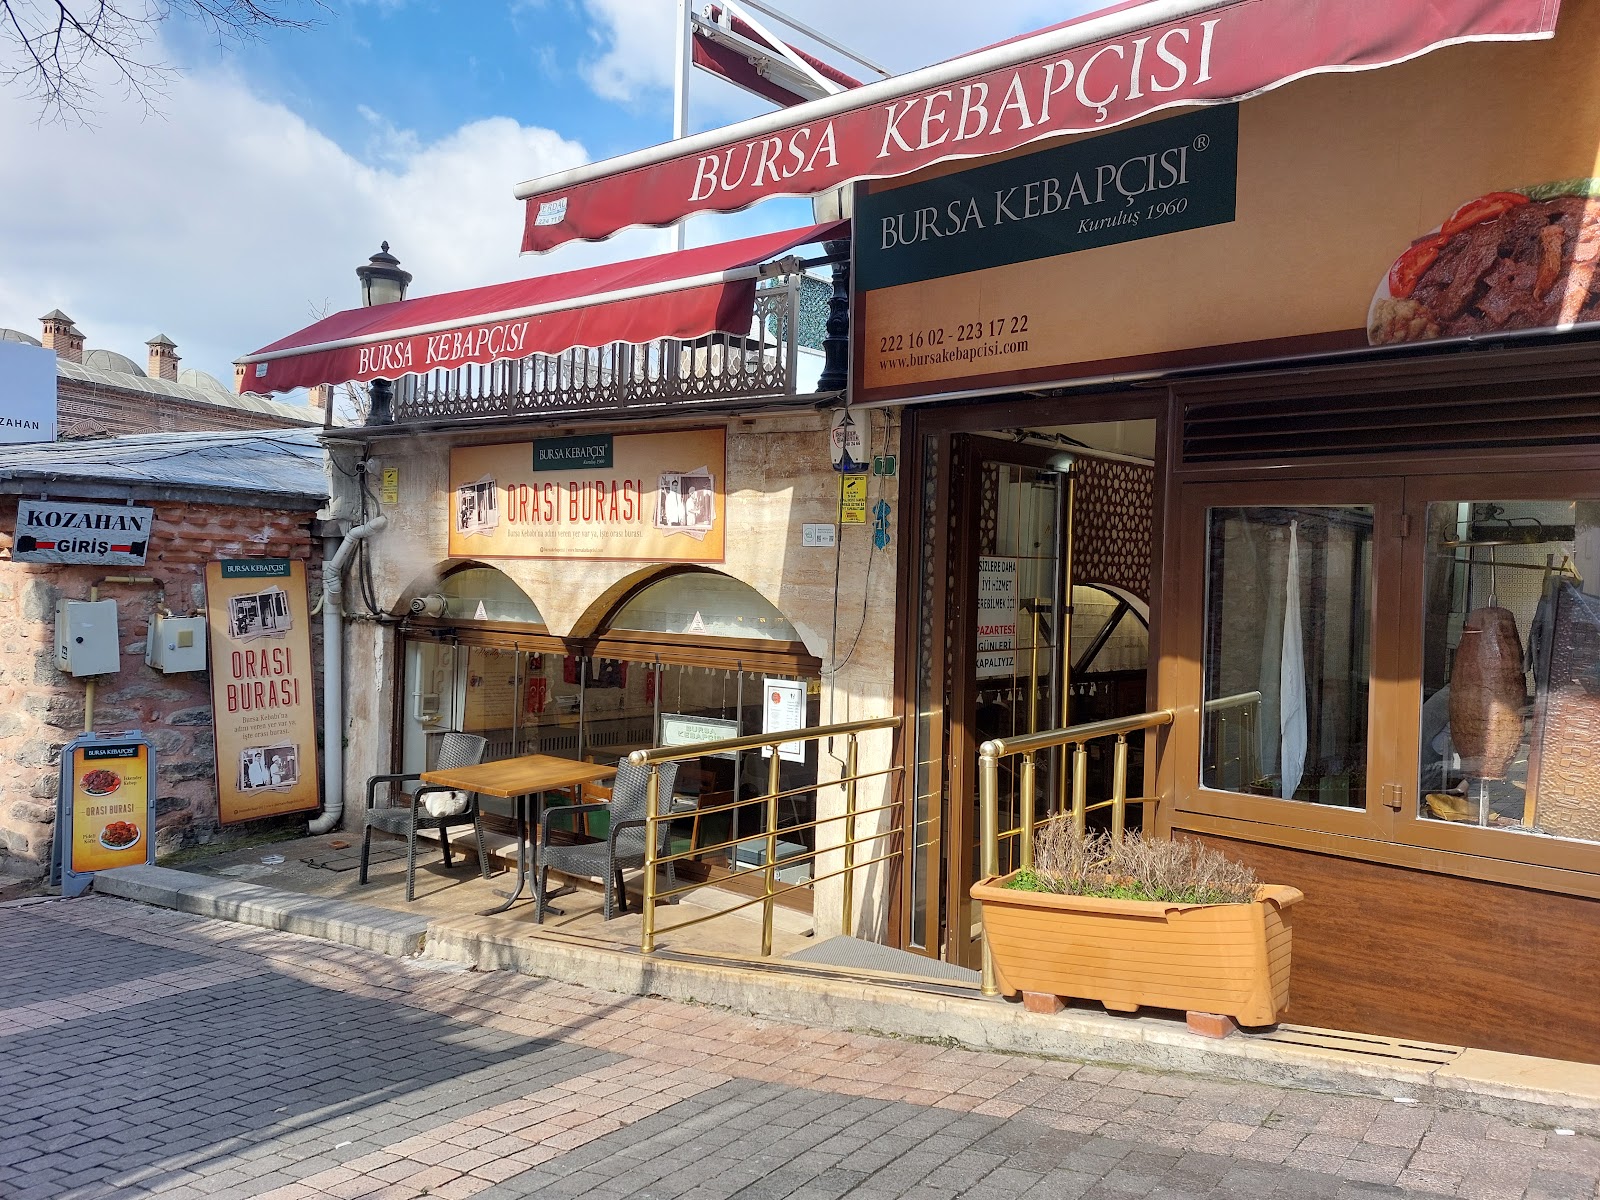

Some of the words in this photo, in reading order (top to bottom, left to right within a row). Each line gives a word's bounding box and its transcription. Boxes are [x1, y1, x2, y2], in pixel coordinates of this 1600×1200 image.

[687, 119, 840, 202] BURSA
[875, 17, 1222, 159] KEBAPÇISI
[880, 198, 986, 251] BURSA
[1077, 210, 1140, 234] Kuruluş
[1146, 197, 1188, 220] 1960
[357, 340, 413, 375] BURSA
[425, 321, 529, 361] KEBAPÇISI
[880, 334, 903, 353] 222
[909, 330, 924, 349] 16
[928, 328, 944, 346] 02
[957, 321, 983, 342] 223
[989, 318, 1005, 337] 17
[1010, 314, 1028, 334] 22
[879, 340, 1029, 370] www.bursakebapcisi.com
[539, 448, 564, 460] BURSA
[565, 445, 605, 459] KEBAPÇISI
[507, 482, 562, 523] ORASI
[569, 479, 643, 523] BURASI
[27, 510, 146, 532] KOZAHAN
[57, 537, 109, 556] GİRİŞ
[982, 577, 991, 591] İYİ
[992, 577, 1012, 591] HİZMET
[232, 647, 292, 679] ORASI
[227, 678, 300, 712] BURASI
[86, 806, 107, 817] ORASI
[109, 803, 134, 815] BURASI
